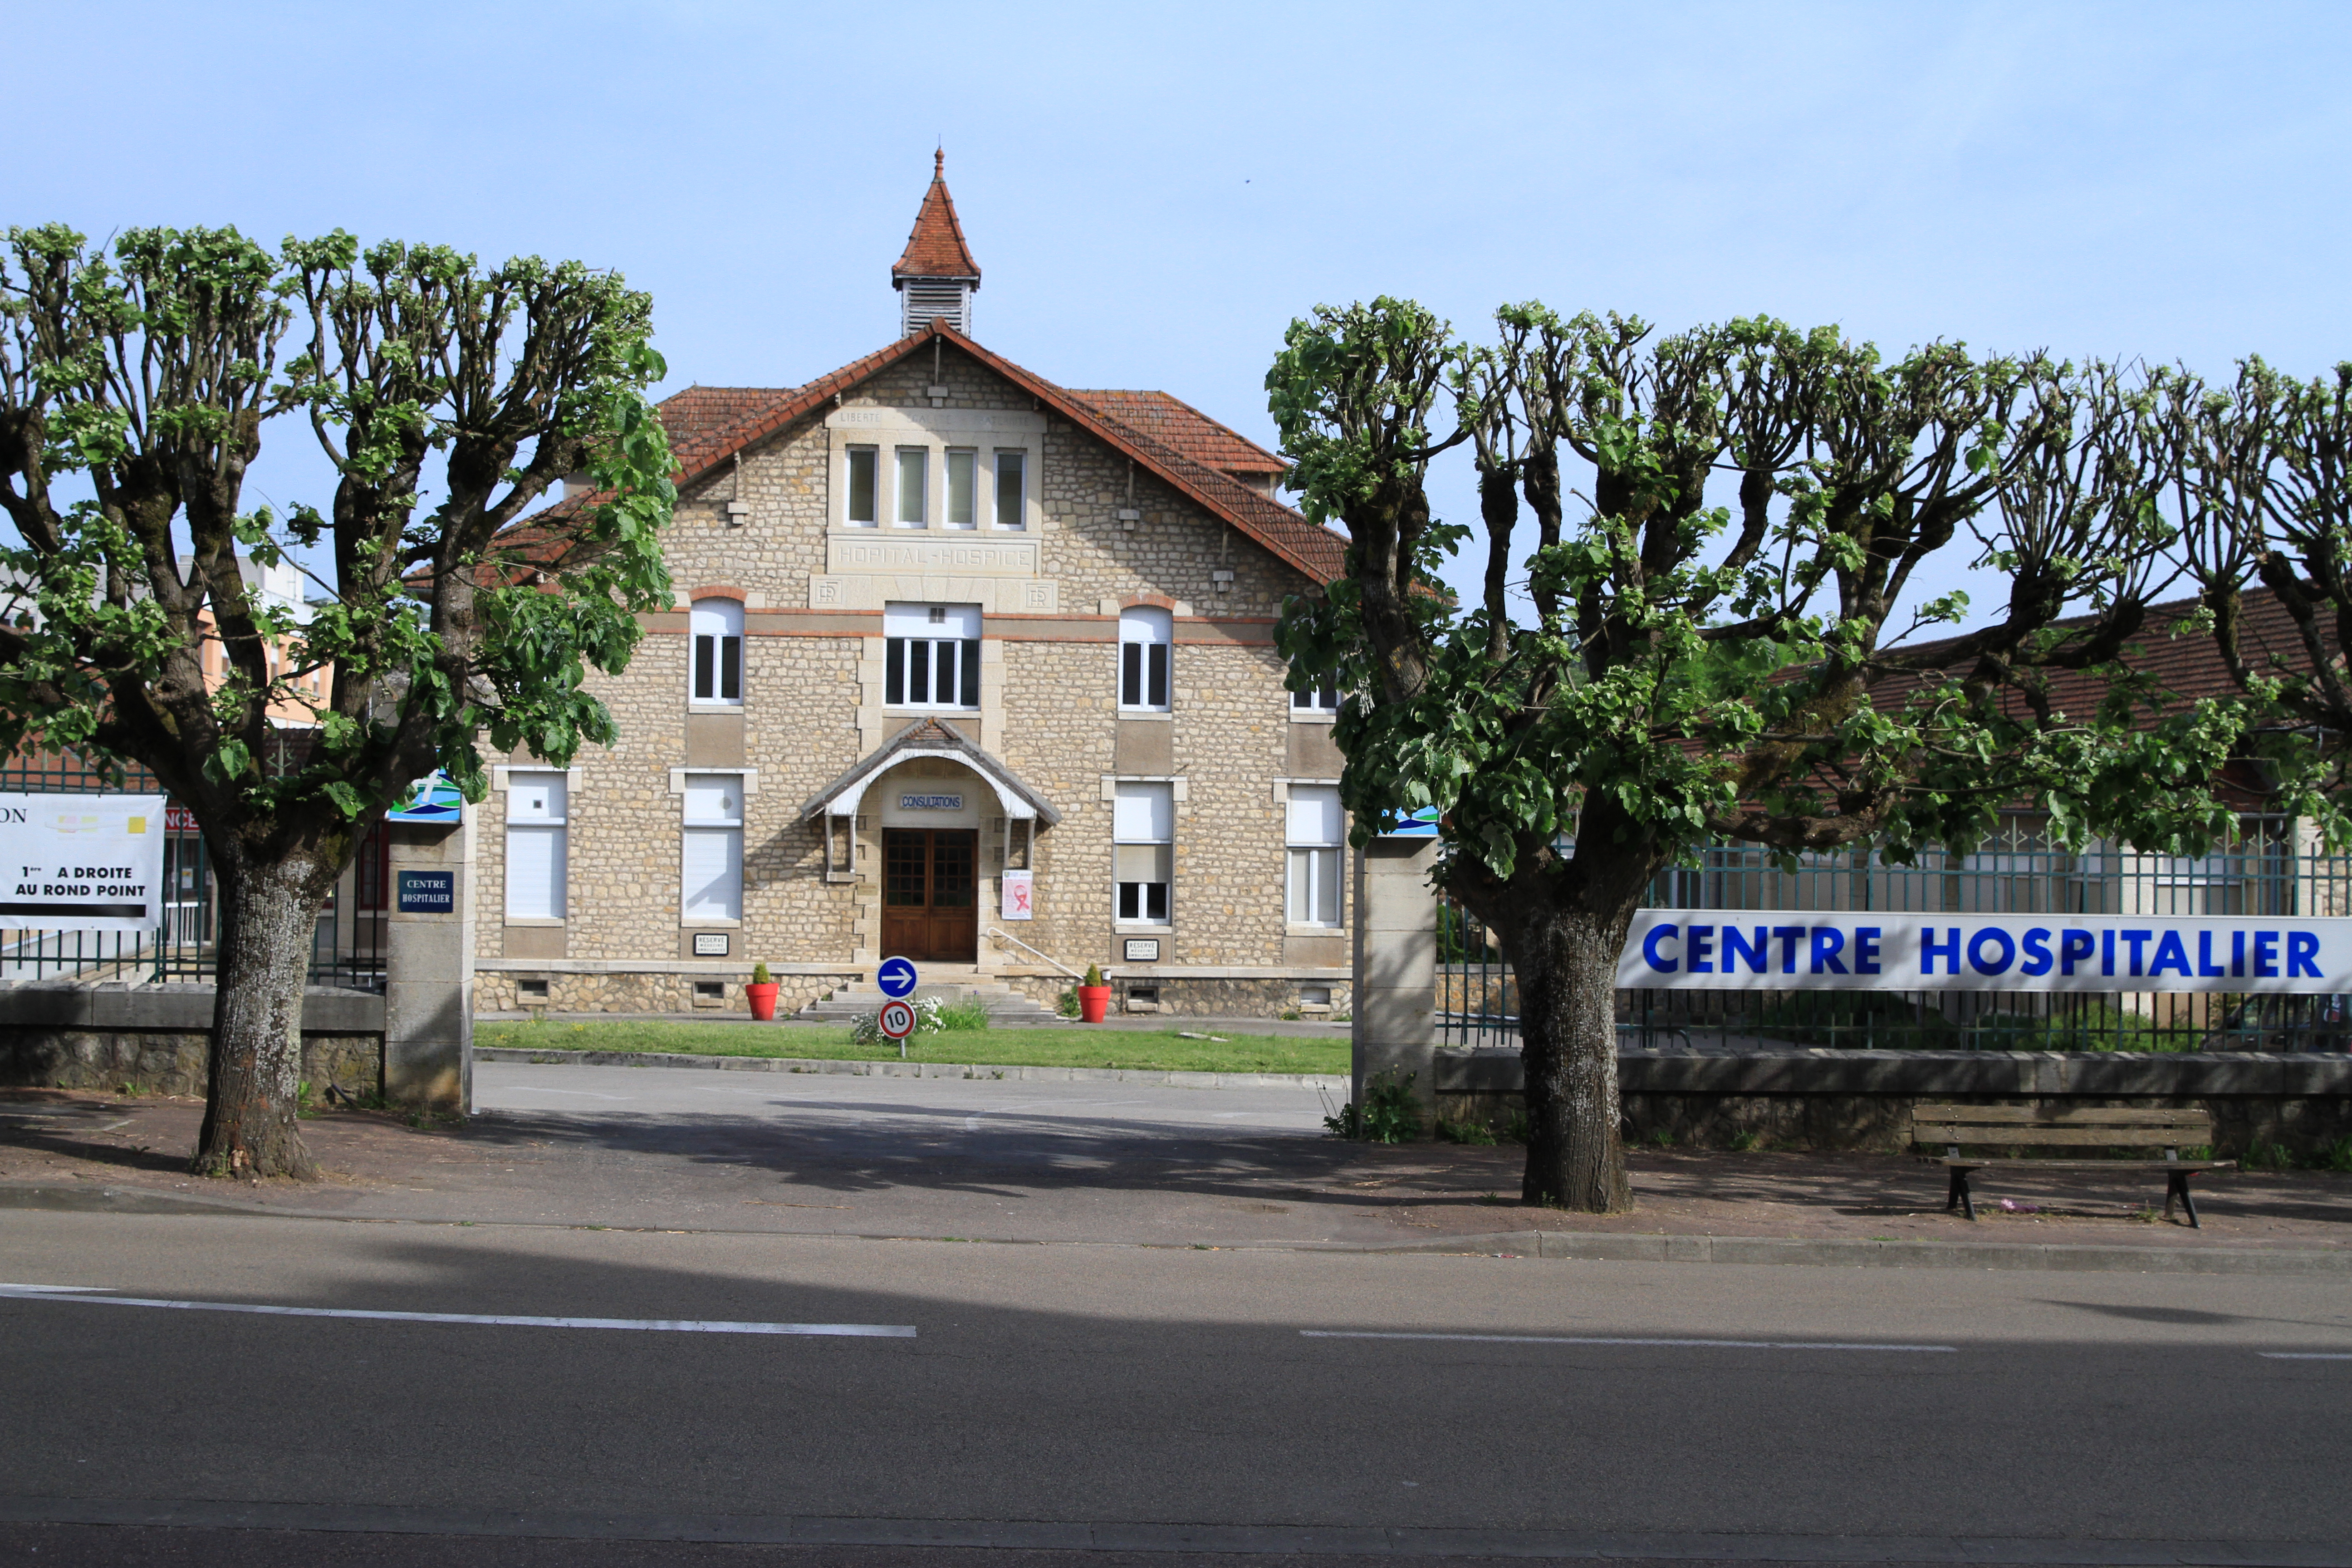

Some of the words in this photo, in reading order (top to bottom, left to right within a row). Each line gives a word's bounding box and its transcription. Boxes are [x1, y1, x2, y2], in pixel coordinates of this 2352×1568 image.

[902, 796, 960, 808] CONSULTATIONS
[58, 867, 68, 878] A
[74, 867, 132, 878] DROITE
[407, 880, 446, 888] CENTRE
[16, 884, 37, 895] AU
[44, 885, 90, 896] ROND
[97, 885, 145, 897] POINT
[402, 893, 450, 903] HOSPITALIER
[1642, 924, 1881, 975] CENTRE
[1921, 927, 2325, 978] HOSPITALIER
[887, 1010, 906, 1028] 10
